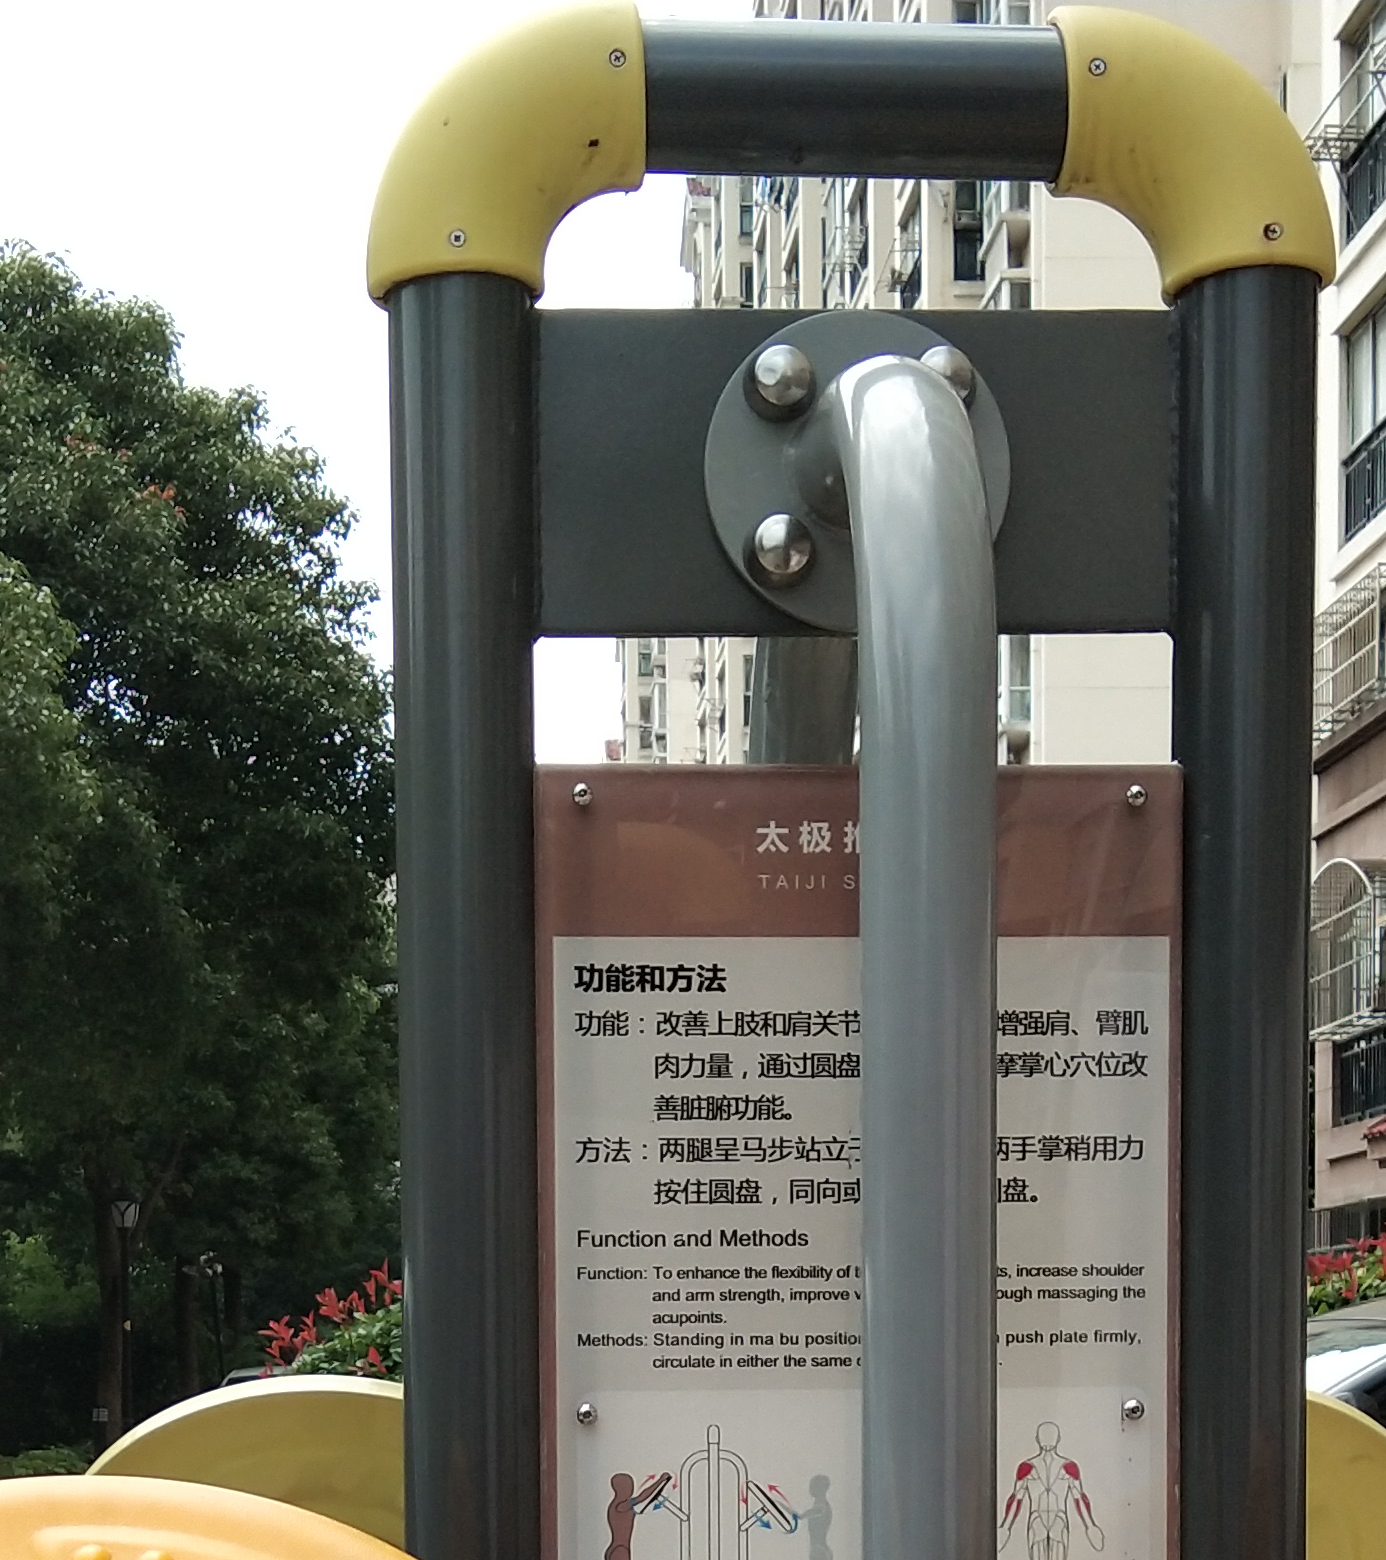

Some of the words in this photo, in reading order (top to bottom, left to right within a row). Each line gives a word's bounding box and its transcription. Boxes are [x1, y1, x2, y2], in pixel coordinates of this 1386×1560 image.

[757, 874, 826, 890] TAIJI
[573, 962, 727, 994] 功能和方法
[653, 1093, 793, 1122] 善脏腑功能。
[576, 1229, 666, 1249] Function
[673, 1229, 712, 1248] and
[719, 1228, 810, 1248] Methods
[576, 1266, 648, 1281] Function:
[653, 1265, 673, 1280] To
[676, 1265, 741, 1280] enhance
[743, 1265, 768, 1280] the
[771, 1264, 833, 1282] flexibility
[836, 1264, 853, 1280] of
[1016, 1264, 1078, 1278] increase
[1082, 1263, 1145, 1277] shoulder
[652, 1288, 681, 1302] and
[685, 1290, 715, 1302] arm
[719, 1287, 786, 1305] strength,
[789, 1287, 851, 1305] improve
[1037, 1285, 1118, 1302] massaging
[1122, 1285, 1146, 1299] the
[652, 1310, 728, 1328] acupoints.
[577, 1333, 648, 1348] Methods:
[653, 1331, 724, 1349] Standing
[730, 1331, 744, 1346] in
[749, 1334, 774, 1346] ma
[779, 1332, 800, 1346] bu
[1005, 1330, 1044, 1347] push
[1049, 1329, 1089, 1347] plate
[1094, 1329, 1142, 1346] firmly,
[652, 1354, 715, 1369] circulate
[719, 1354, 733, 1368] in
[736, 1353, 780, 1368] either
[783, 1353, 807, 1367] the
[811, 1356, 853, 1368] same
